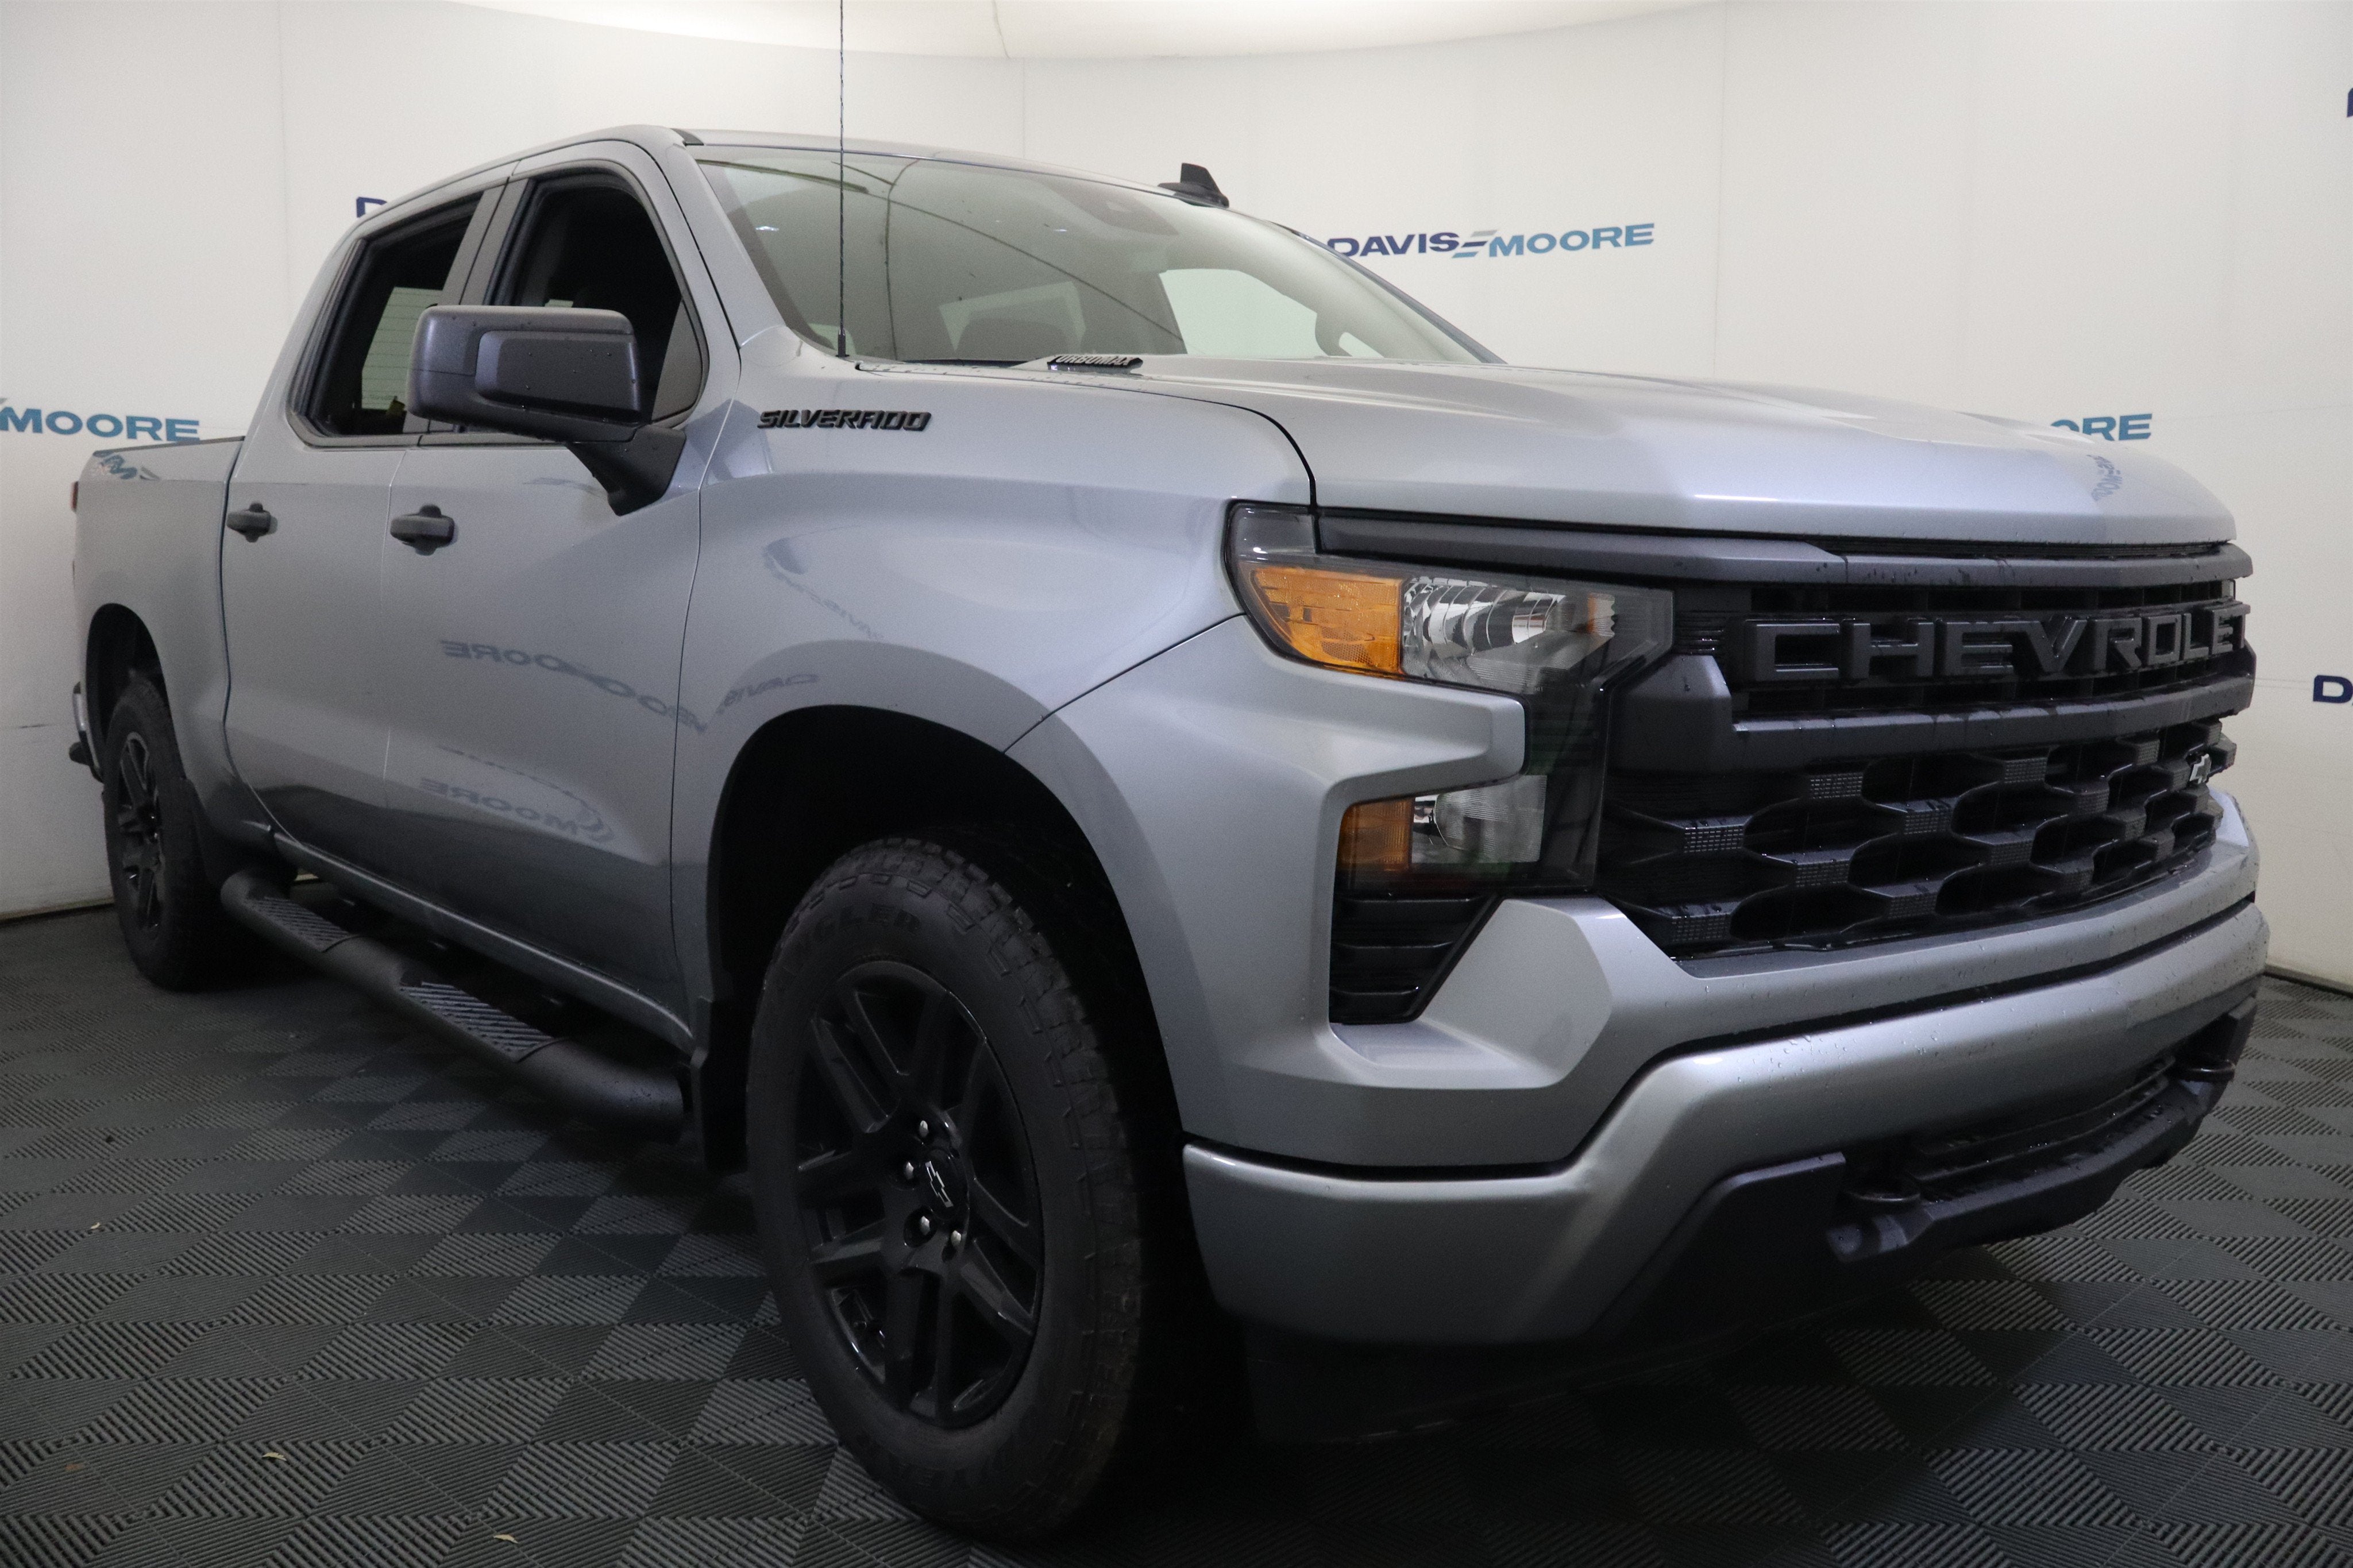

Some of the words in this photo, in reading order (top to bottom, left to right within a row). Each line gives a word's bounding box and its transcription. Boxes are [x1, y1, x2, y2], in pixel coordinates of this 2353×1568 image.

[1326, 231, 1460, 257] DAVIS
[1489, 223, 1654, 257] MOORE
[0, 407, 200, 442] MOORE
[757, 409, 932, 431] SILVERADO
[1745, 601, 2250, 682] CHEVROLET
